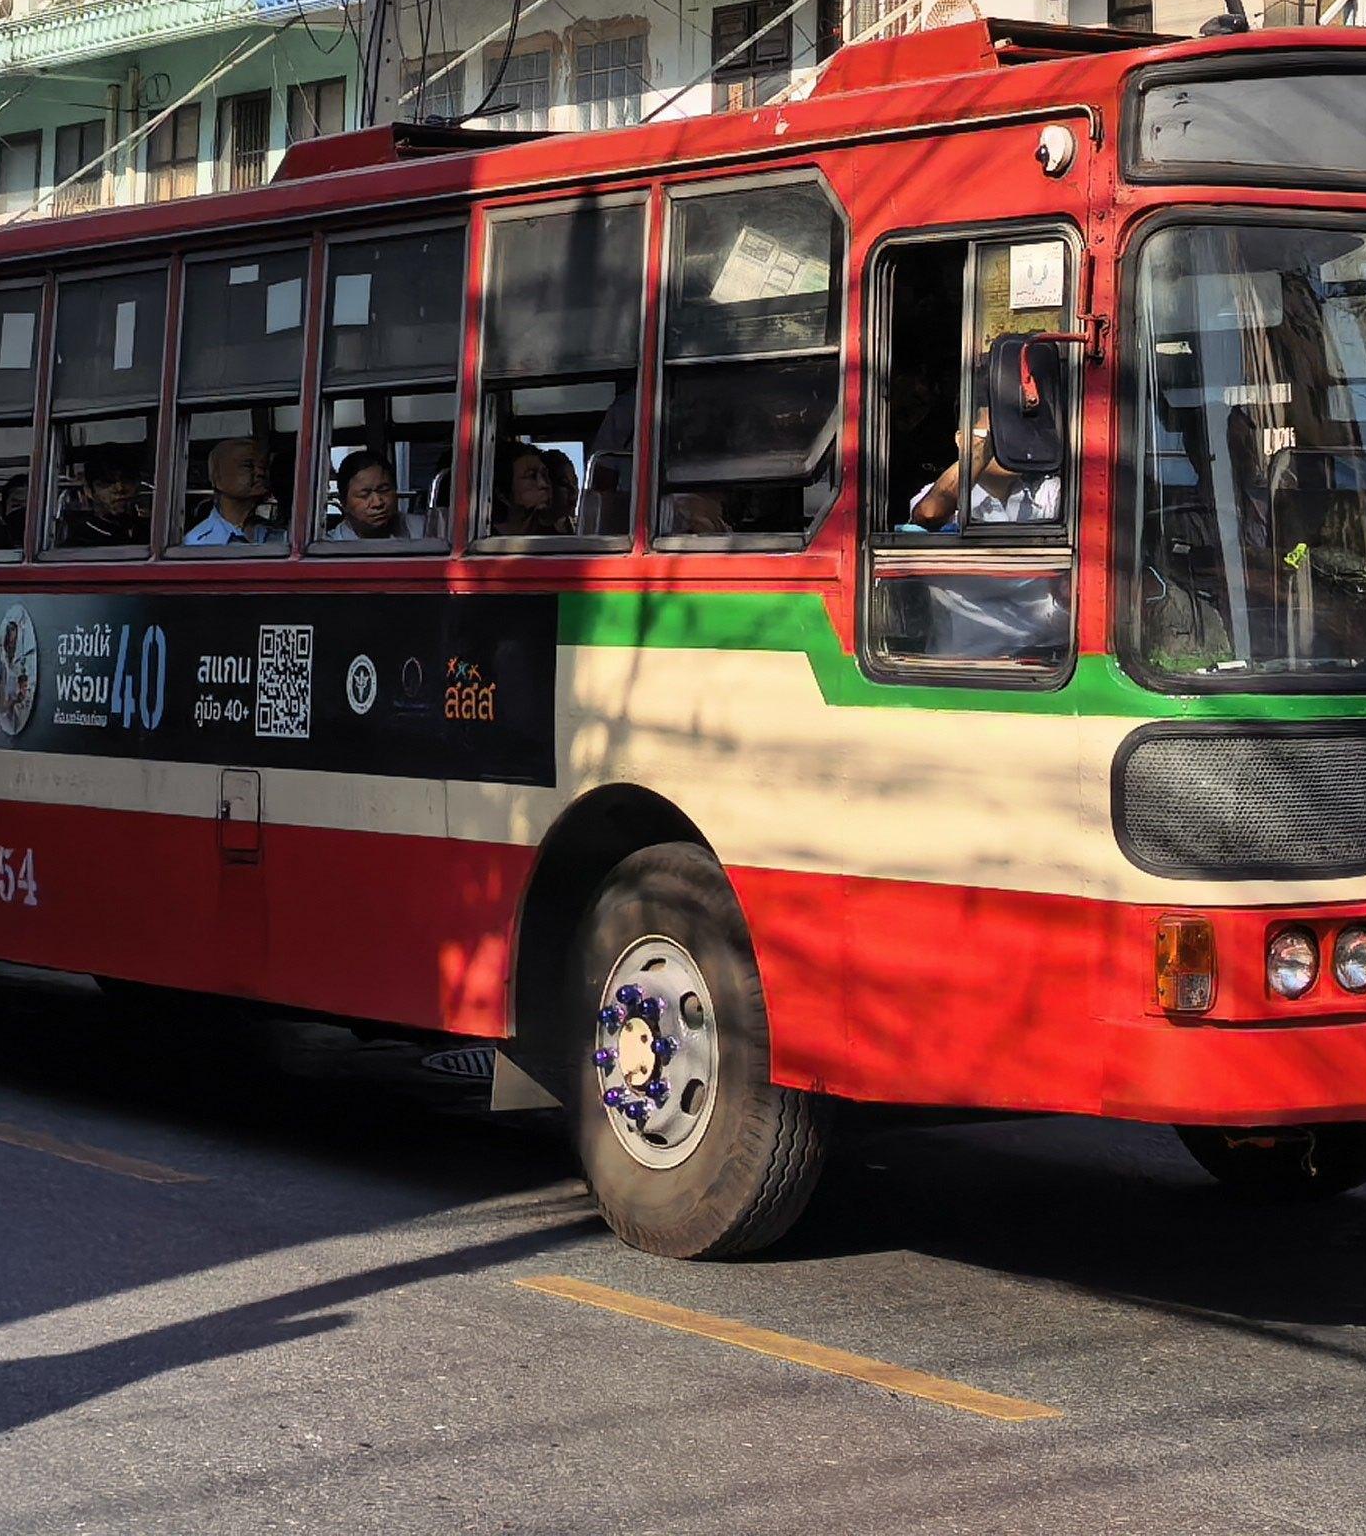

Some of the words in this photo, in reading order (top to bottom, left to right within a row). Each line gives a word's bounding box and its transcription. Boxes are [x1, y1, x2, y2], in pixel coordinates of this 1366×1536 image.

[55, 662, 110, 705] พร้อม
[111, 623, 167, 732] 40
[196, 655, 252, 685] สแกน
[223, 698, 250, 723] 40+
[445, 681, 497, 721] สสส
